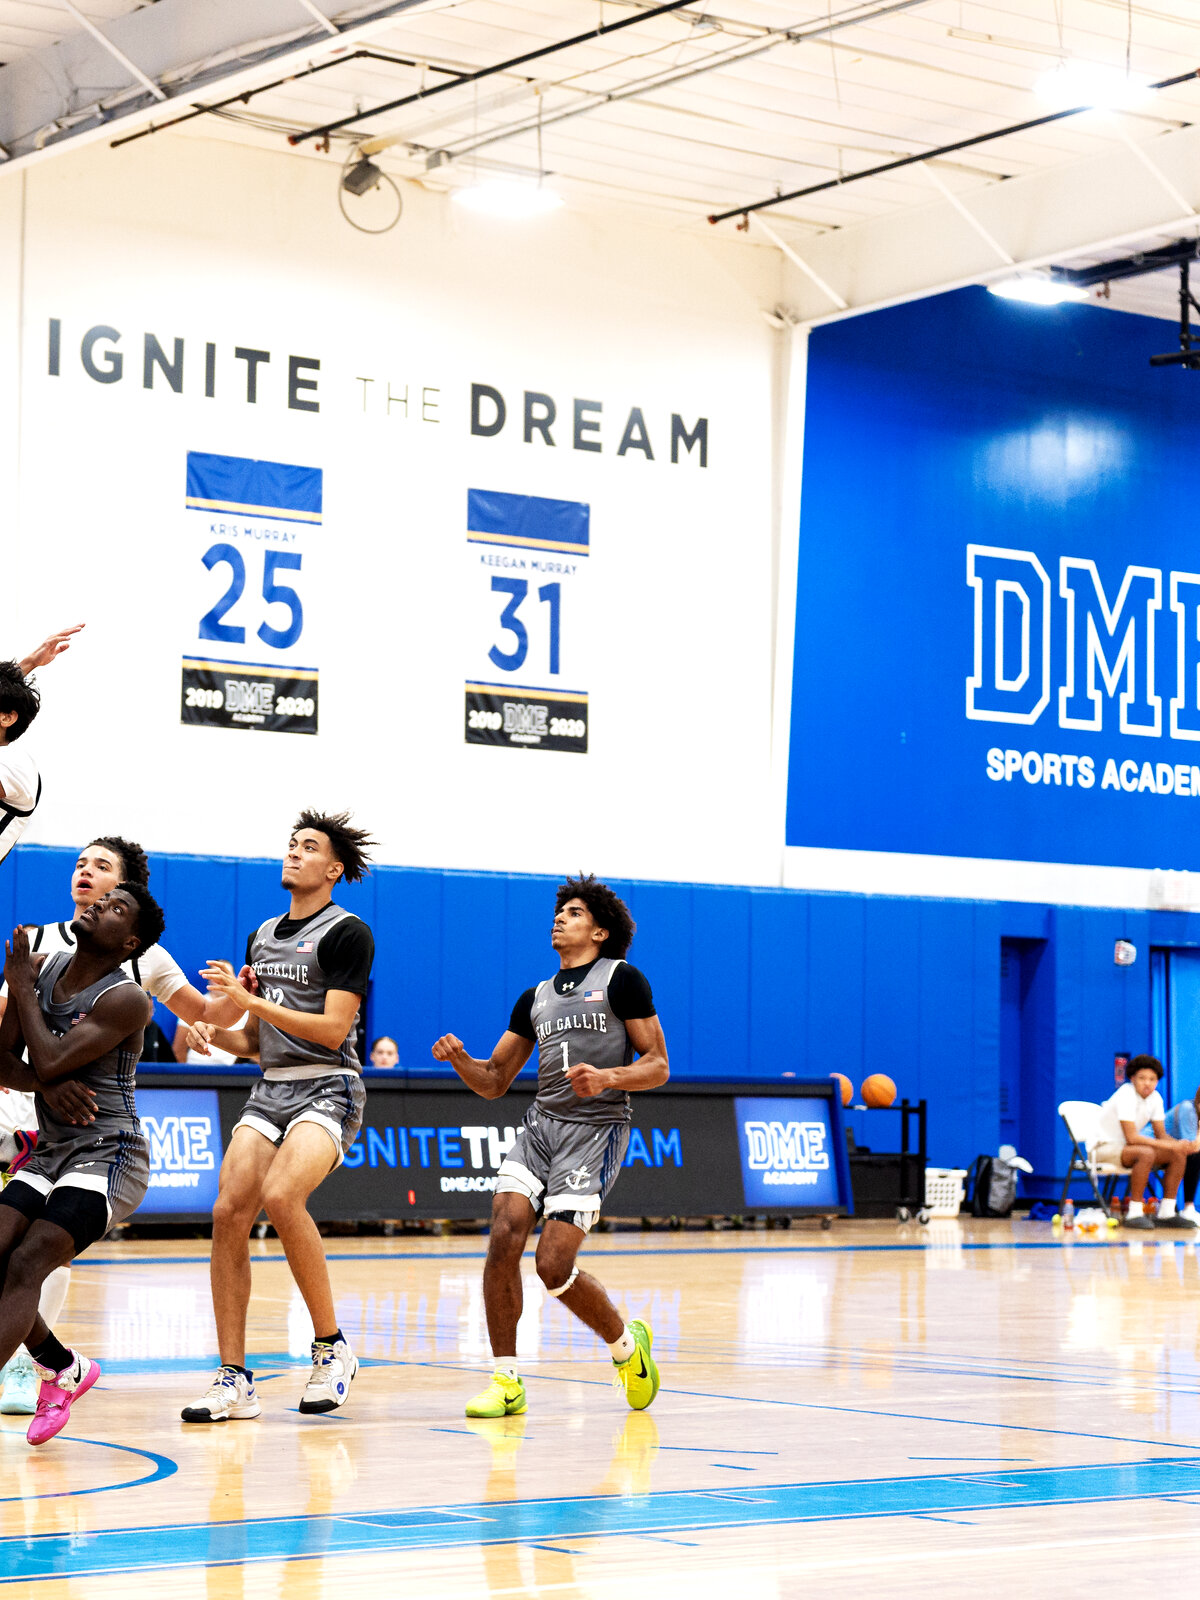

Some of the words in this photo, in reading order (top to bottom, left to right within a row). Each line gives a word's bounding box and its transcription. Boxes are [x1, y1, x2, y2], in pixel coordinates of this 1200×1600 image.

[47, 318, 321, 414] IGNITE
[356, 376, 441, 424] THE
[470, 382, 709, 468] DREAM
[210, 524, 239, 538] KRIS
[244, 528, 297, 543] MURRAY
[480, 554, 527, 569] KEEGAN
[531, 560, 577, 576] MURRAY
[198, 542, 304, 650] 25
[487, 575, 561, 675] 31
[185, 687, 224, 710] 2019
[224, 679, 276, 715] DME
[275, 696, 315, 717] 2020
[503, 702, 549, 736] DME
[550, 717, 586, 738] 2020
[986, 748, 1096, 789] SPORTS
[266, 963, 309, 986] GALLIE
[557, 1012, 607, 1033] GALLIE
[560, 1040, 570, 1072] 1
[140, 1116, 215, 1170] ME
[745, 1121, 830, 1170] DME
